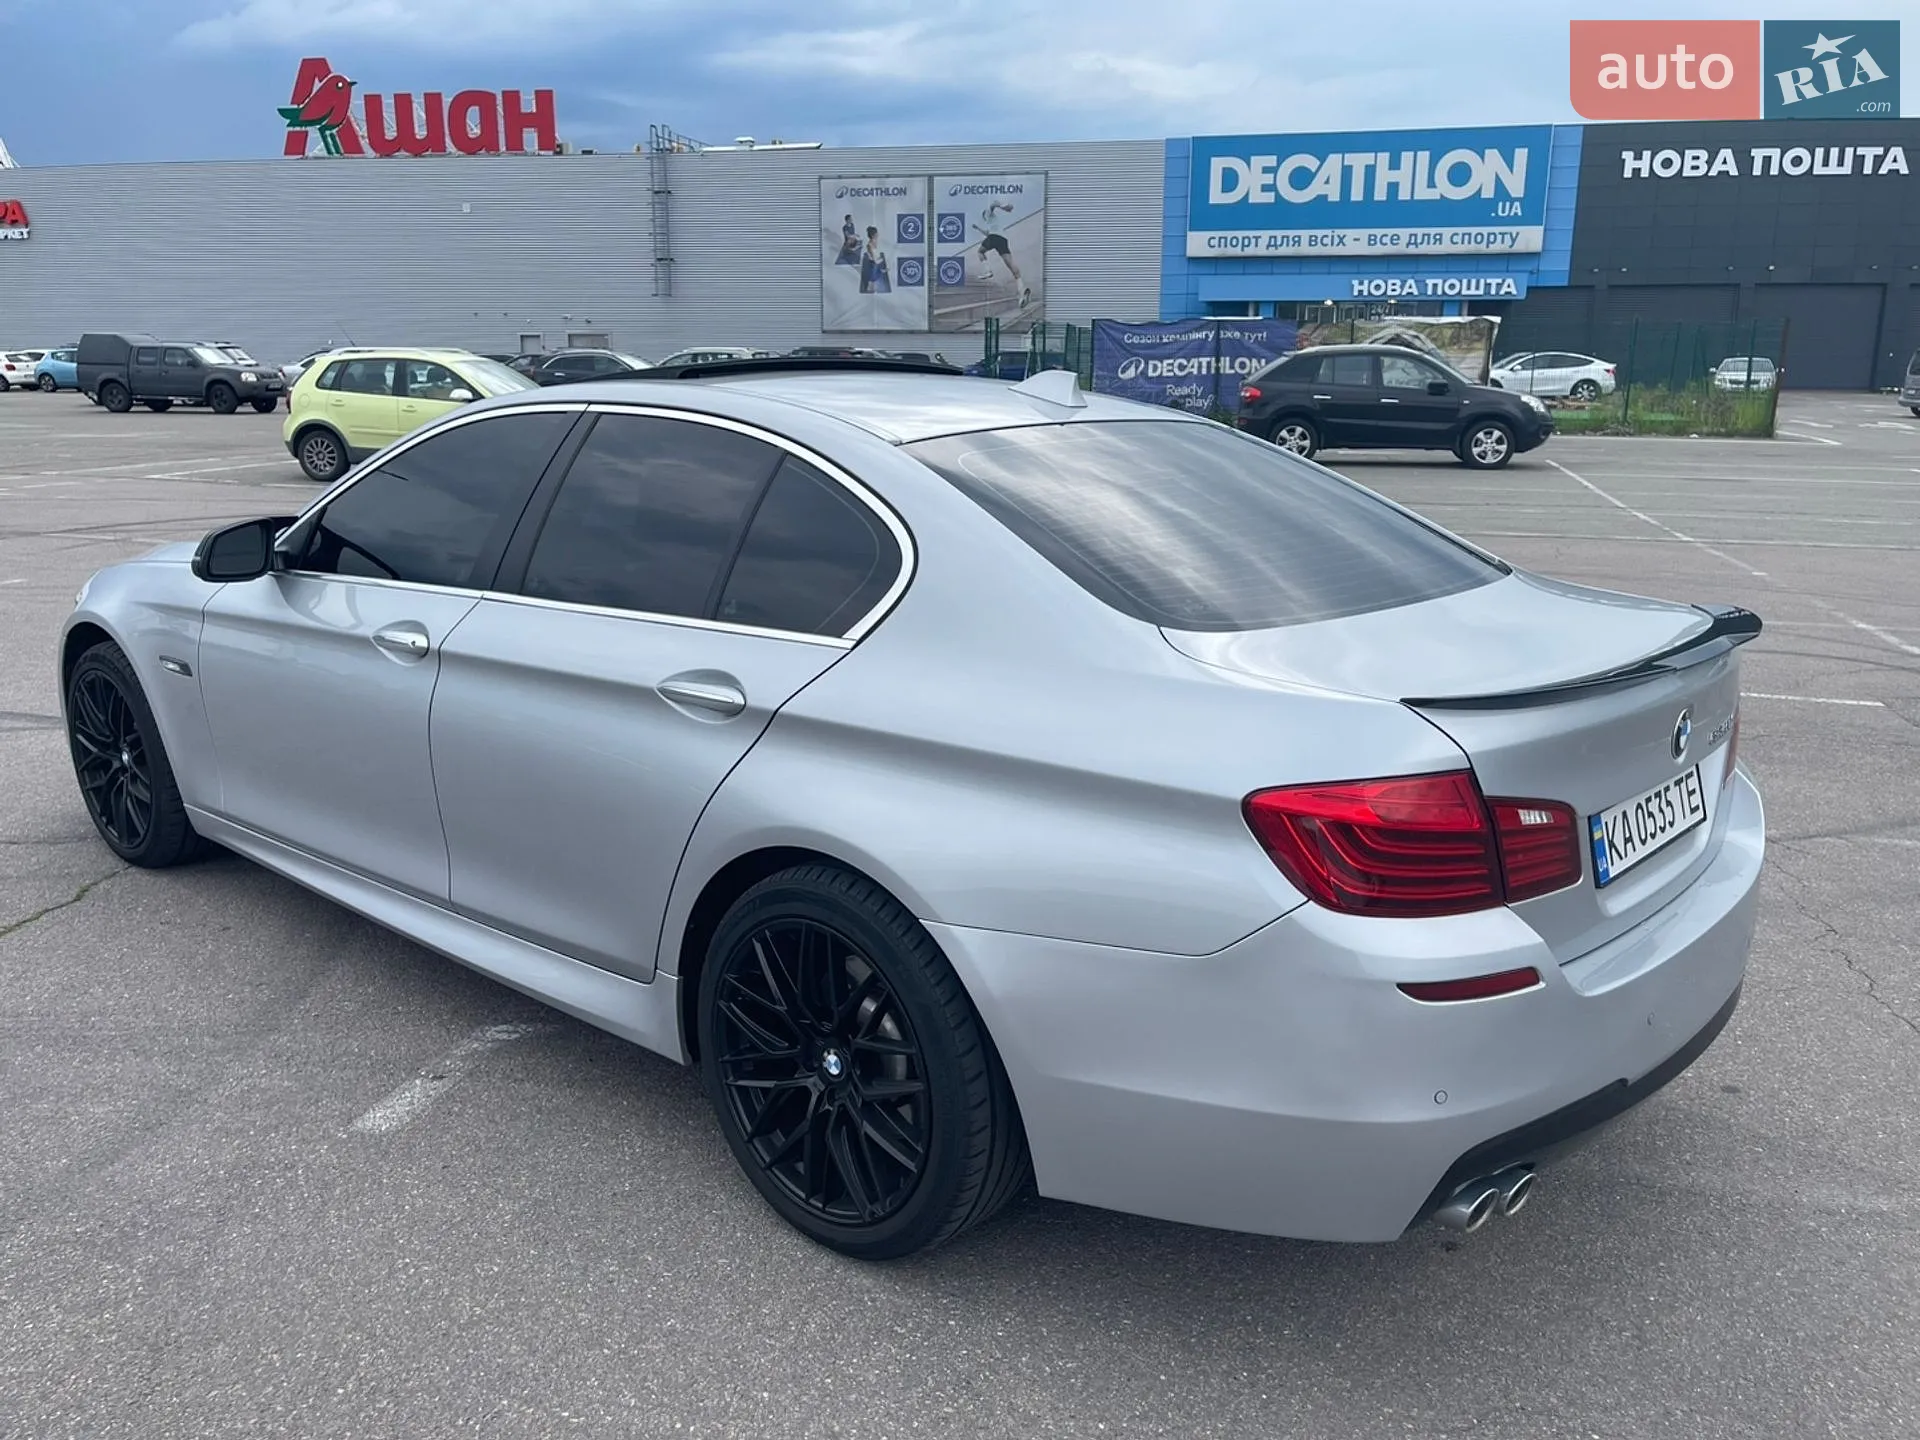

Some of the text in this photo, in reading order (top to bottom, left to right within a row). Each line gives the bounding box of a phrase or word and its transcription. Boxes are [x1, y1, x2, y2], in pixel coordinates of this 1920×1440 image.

[1621, 146, 1910, 178] НОВА ПОШТА
[1209, 147, 1529, 205] DECATHLON
[850, 187, 907, 197] DECATHLON
[964, 184, 1023, 195] DECATHLON
[1491, 201, 1522, 217] .UA
[1207, 232, 1262, 252] спорт
[1266, 232, 1302, 250] для
[1308, 229, 1346, 247] всіх
[1367, 232, 1401, 246] все
[1406, 229, 1443, 247] для
[1450, 230, 1520, 249] спорту
[1352, 278, 1517, 297] НОВА ПОШТА
[1243, 331, 1267, 343] тут!
[1147, 357, 1266, 378] DECATHLON
[1166, 383, 1204, 397] Ready
[1185, 394, 1214, 410] play?
[1604, 770, 1700, 866] KA 0535 TE
